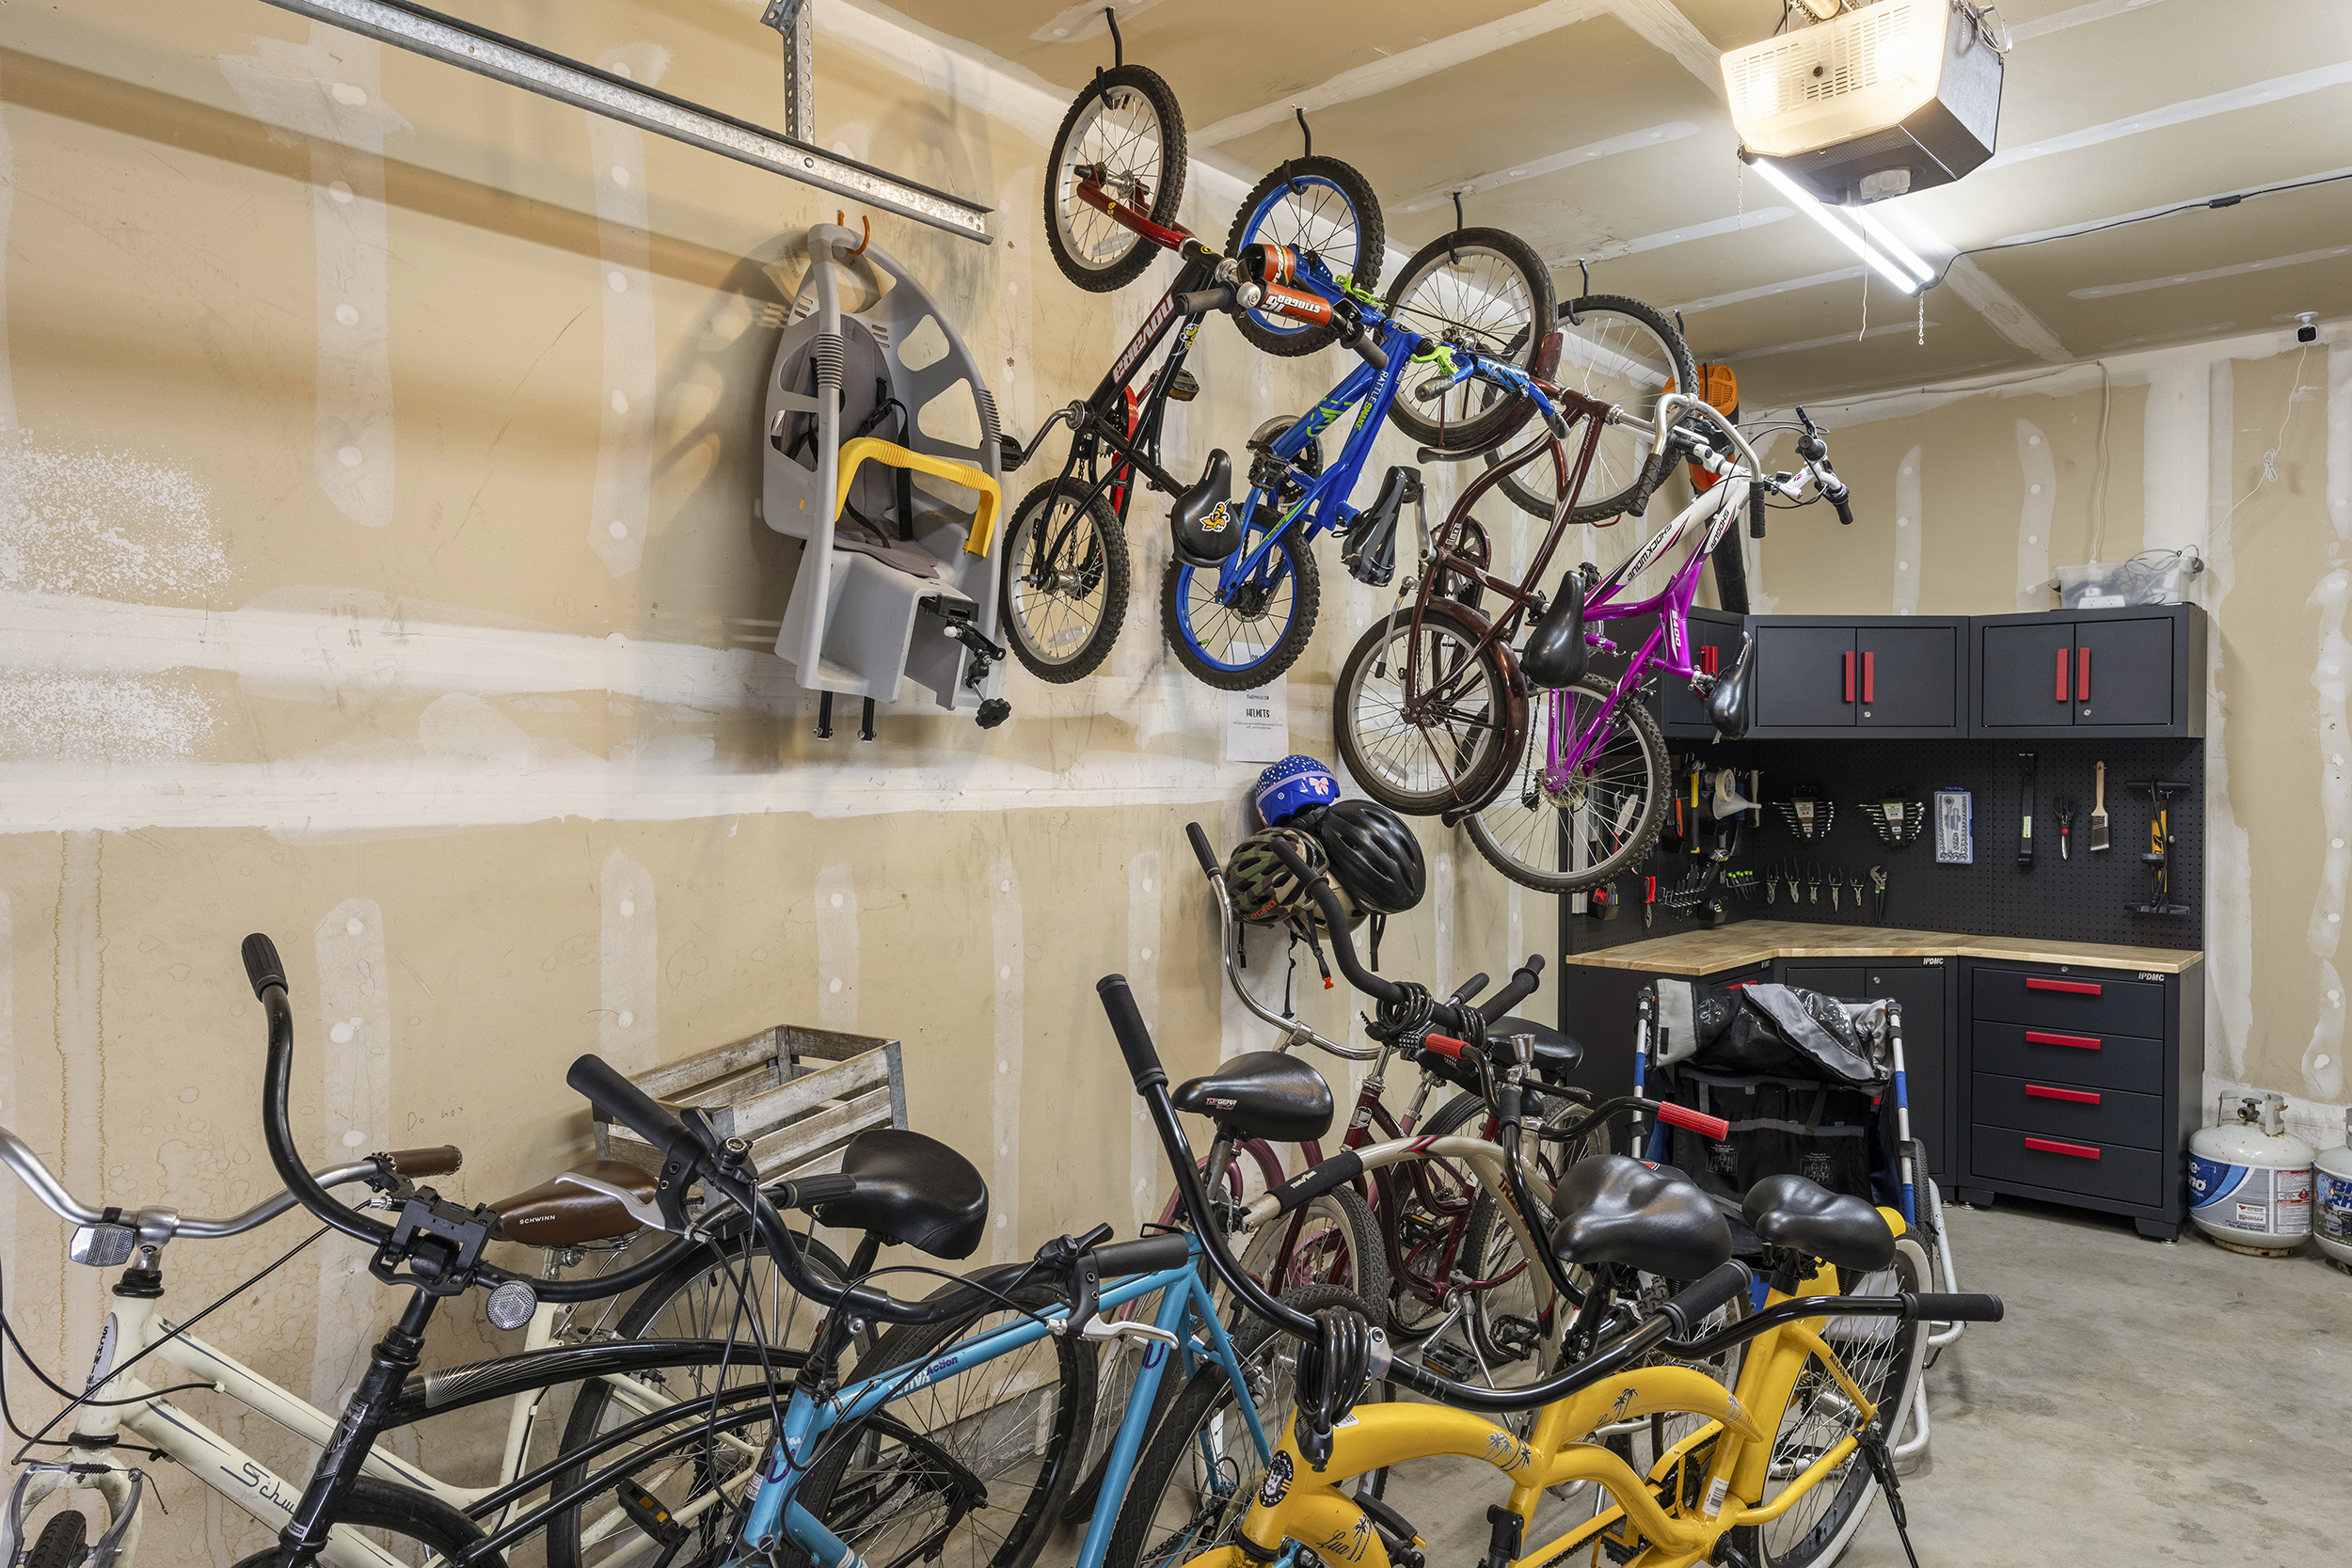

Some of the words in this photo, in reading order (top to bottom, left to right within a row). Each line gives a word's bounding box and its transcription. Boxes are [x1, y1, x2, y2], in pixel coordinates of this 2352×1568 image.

[1261, 294, 1285, 313] 16
[1277, 293, 1322, 314] STINGER
[1368, 370, 1389, 404] RATTLE
[1355, 401, 1373, 432] SNAKE
[1710, 509, 1730, 548] SHOGUN
[1671, 610, 1682, 647] 2400
[1247, 708, 1270, 719] HELMETS
[519, 1214, 556, 1225] SCHWINN
[926, 1355, 959, 1376] Action
[1828, 1353, 1849, 1381] KULANA
[219, 1462, 294, 1515] Schw
[1316, 1529, 1351, 1555] Lua
